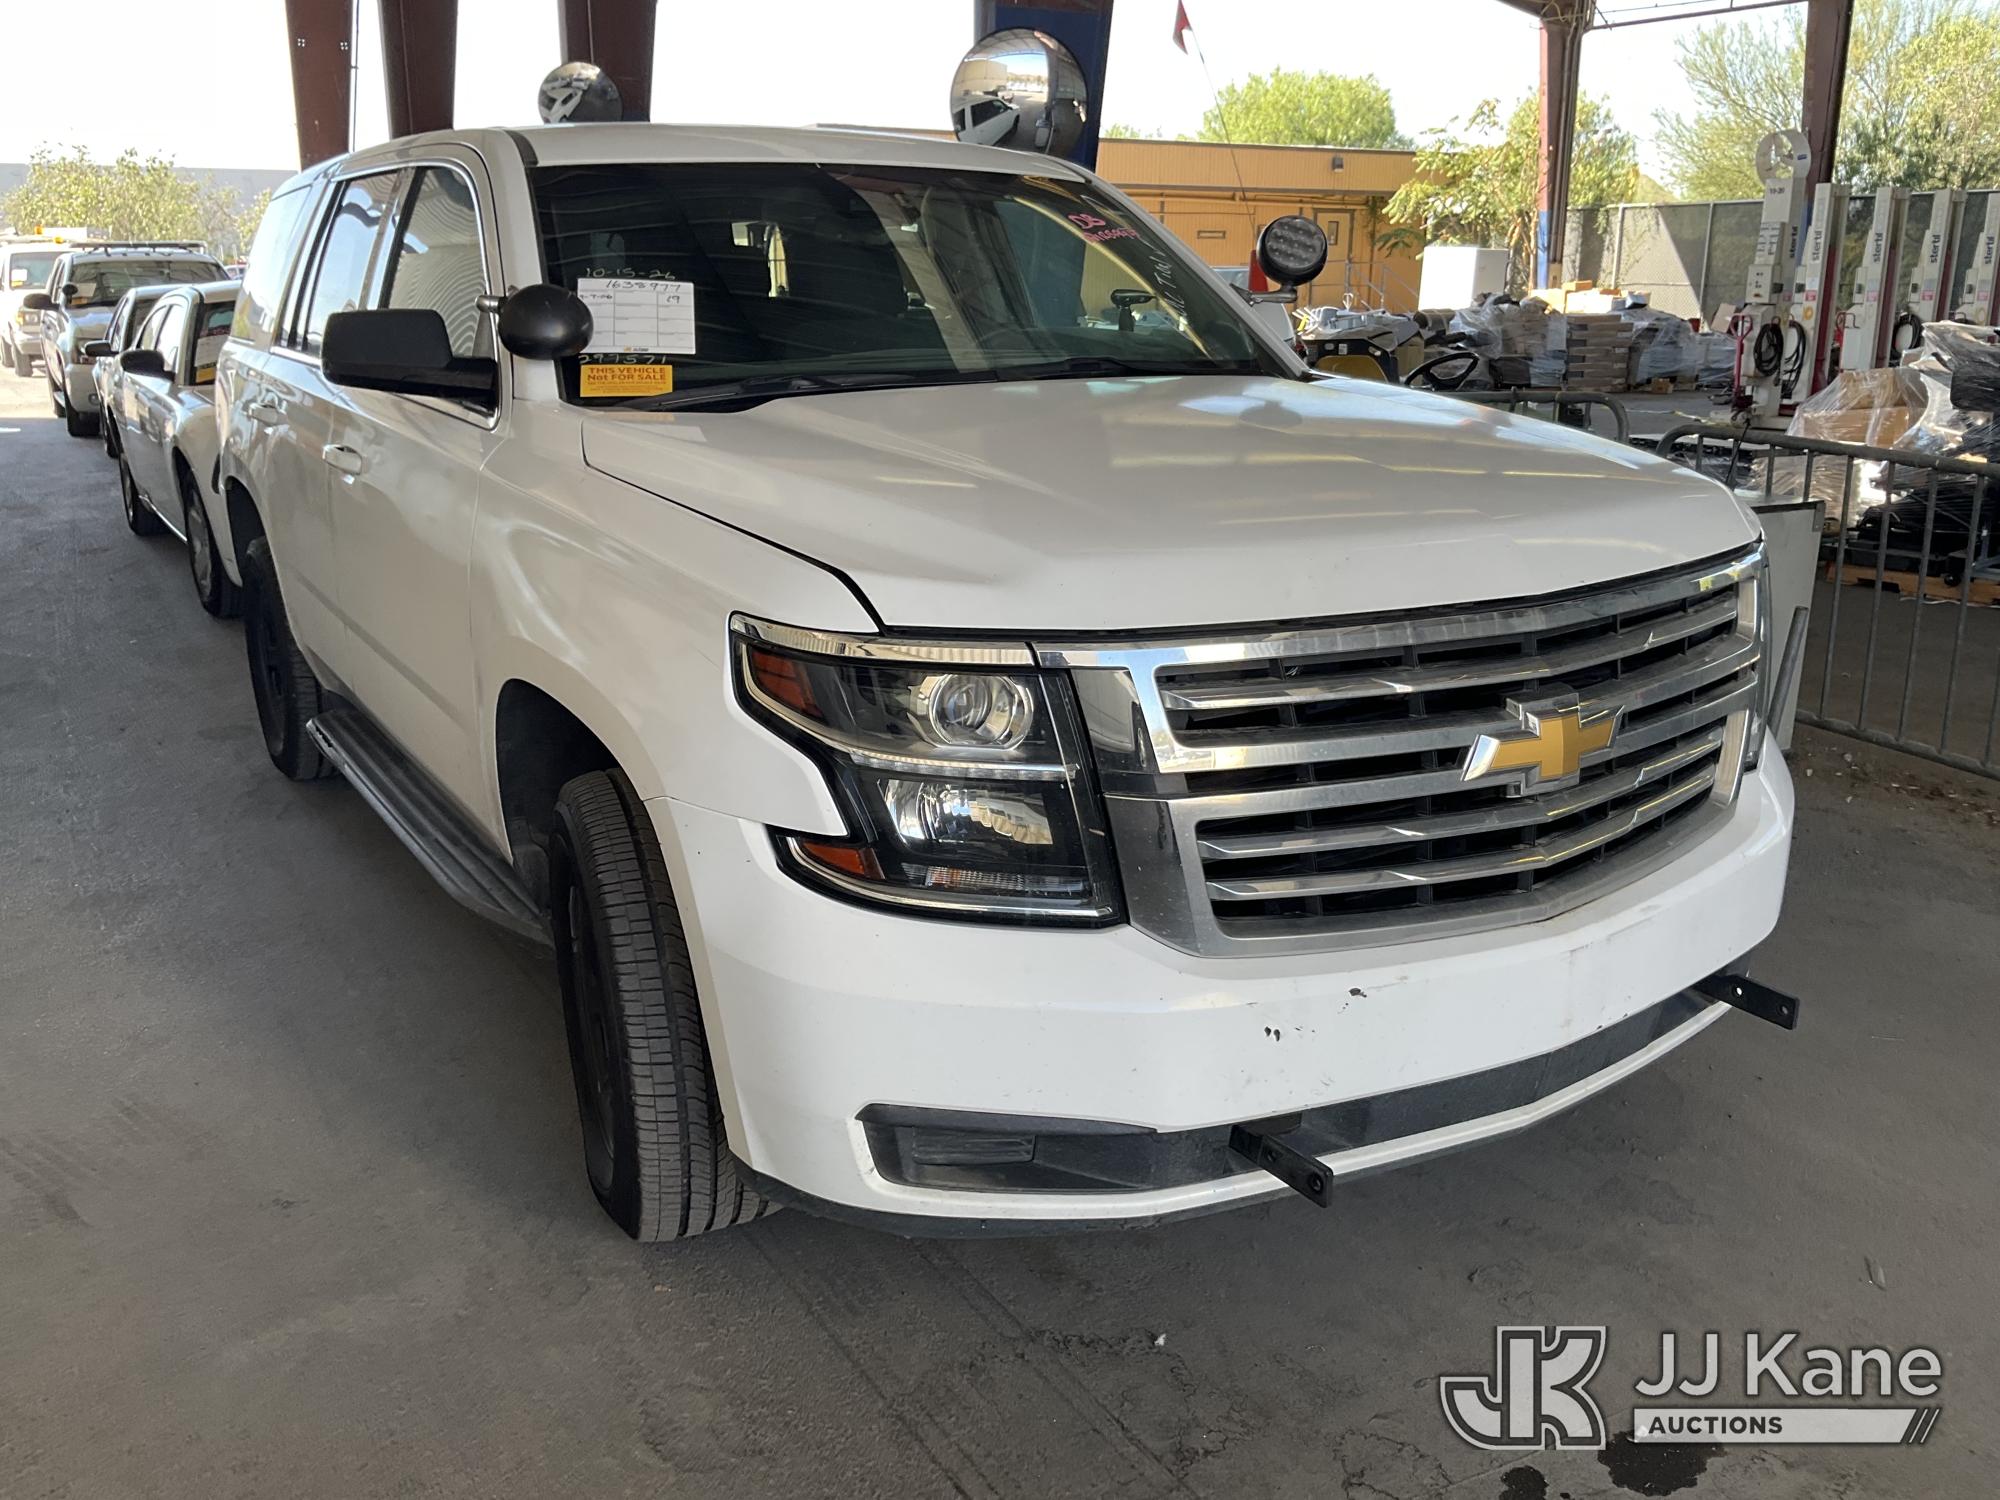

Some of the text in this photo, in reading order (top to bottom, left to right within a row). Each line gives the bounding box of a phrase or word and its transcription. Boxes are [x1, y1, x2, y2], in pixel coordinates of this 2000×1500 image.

[1873, 232, 1884, 263] stertil
[1929, 234, 1941, 264] stertil
[1983, 236, 1995, 265] stertil
